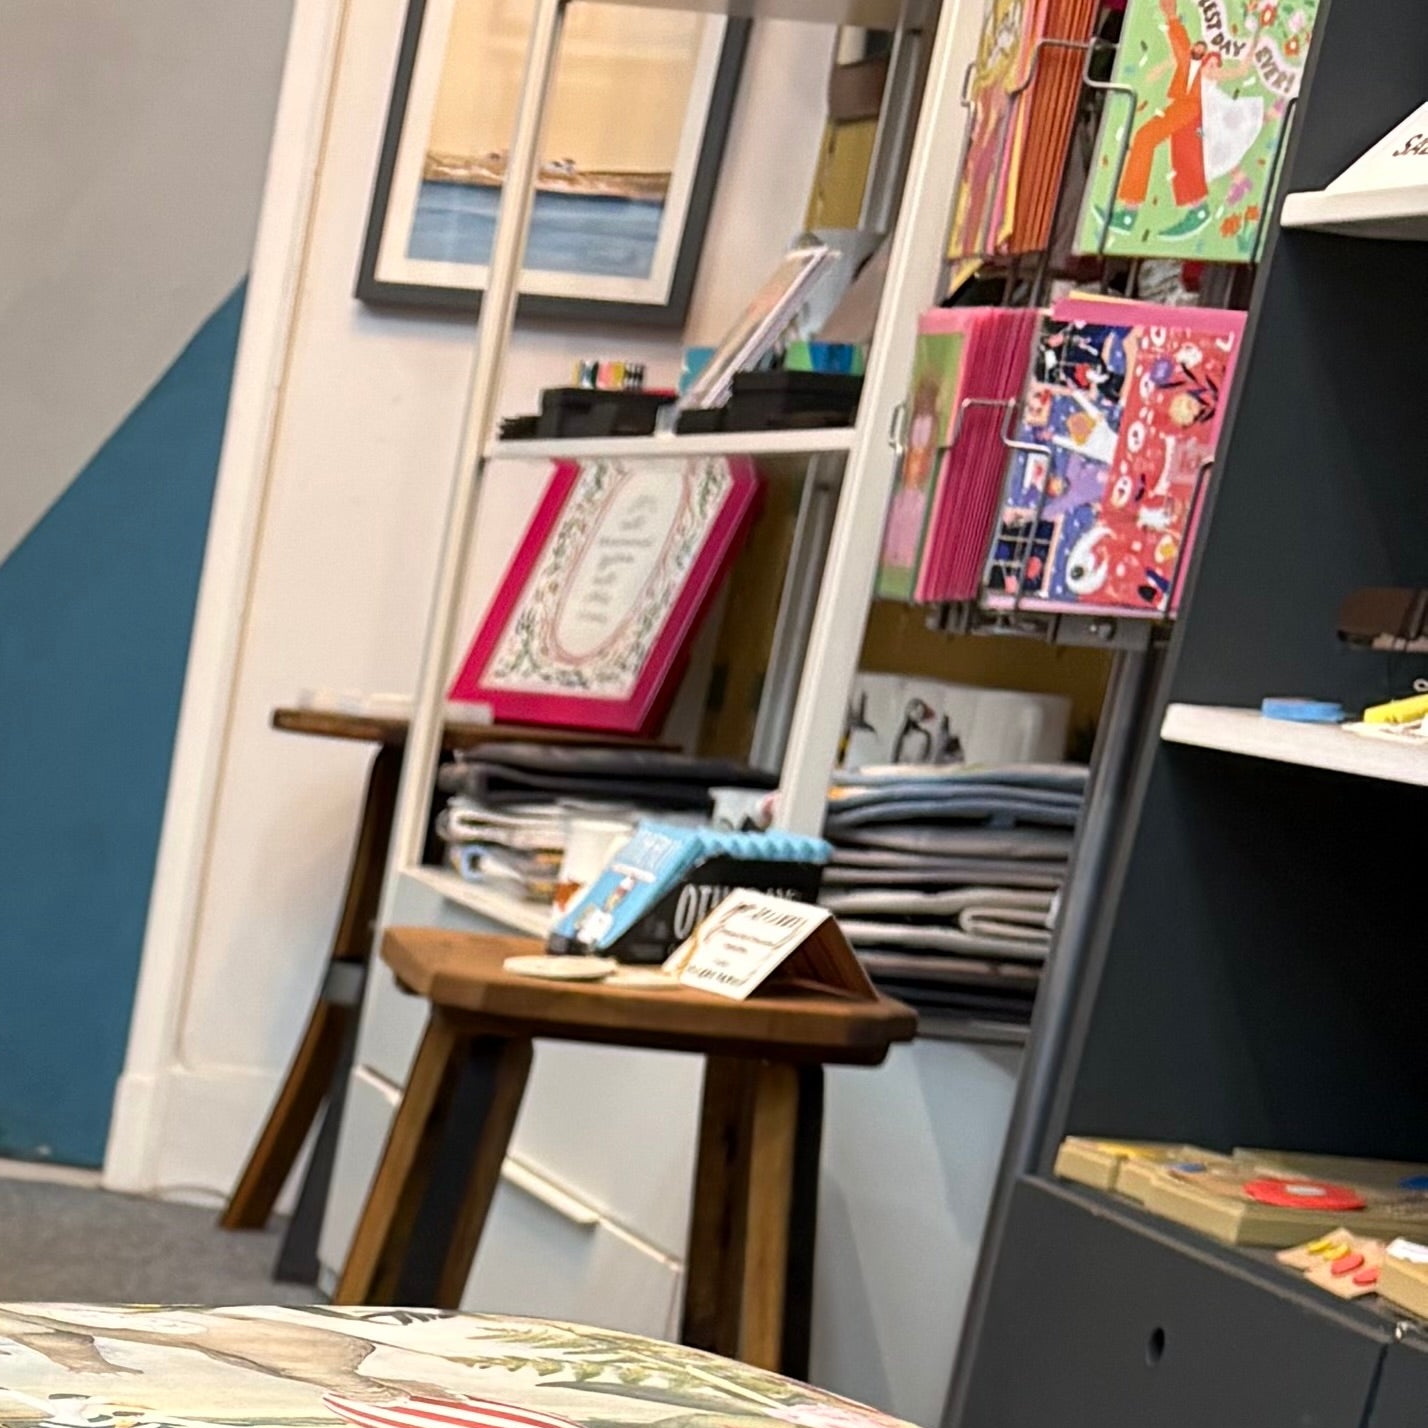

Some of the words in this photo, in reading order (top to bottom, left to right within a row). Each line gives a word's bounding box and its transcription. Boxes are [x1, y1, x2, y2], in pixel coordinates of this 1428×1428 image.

[1197, 0, 1222, 30] EST
[1211, 32, 1247, 57] DAY
[1255, 46, 1296, 93] EVER!
